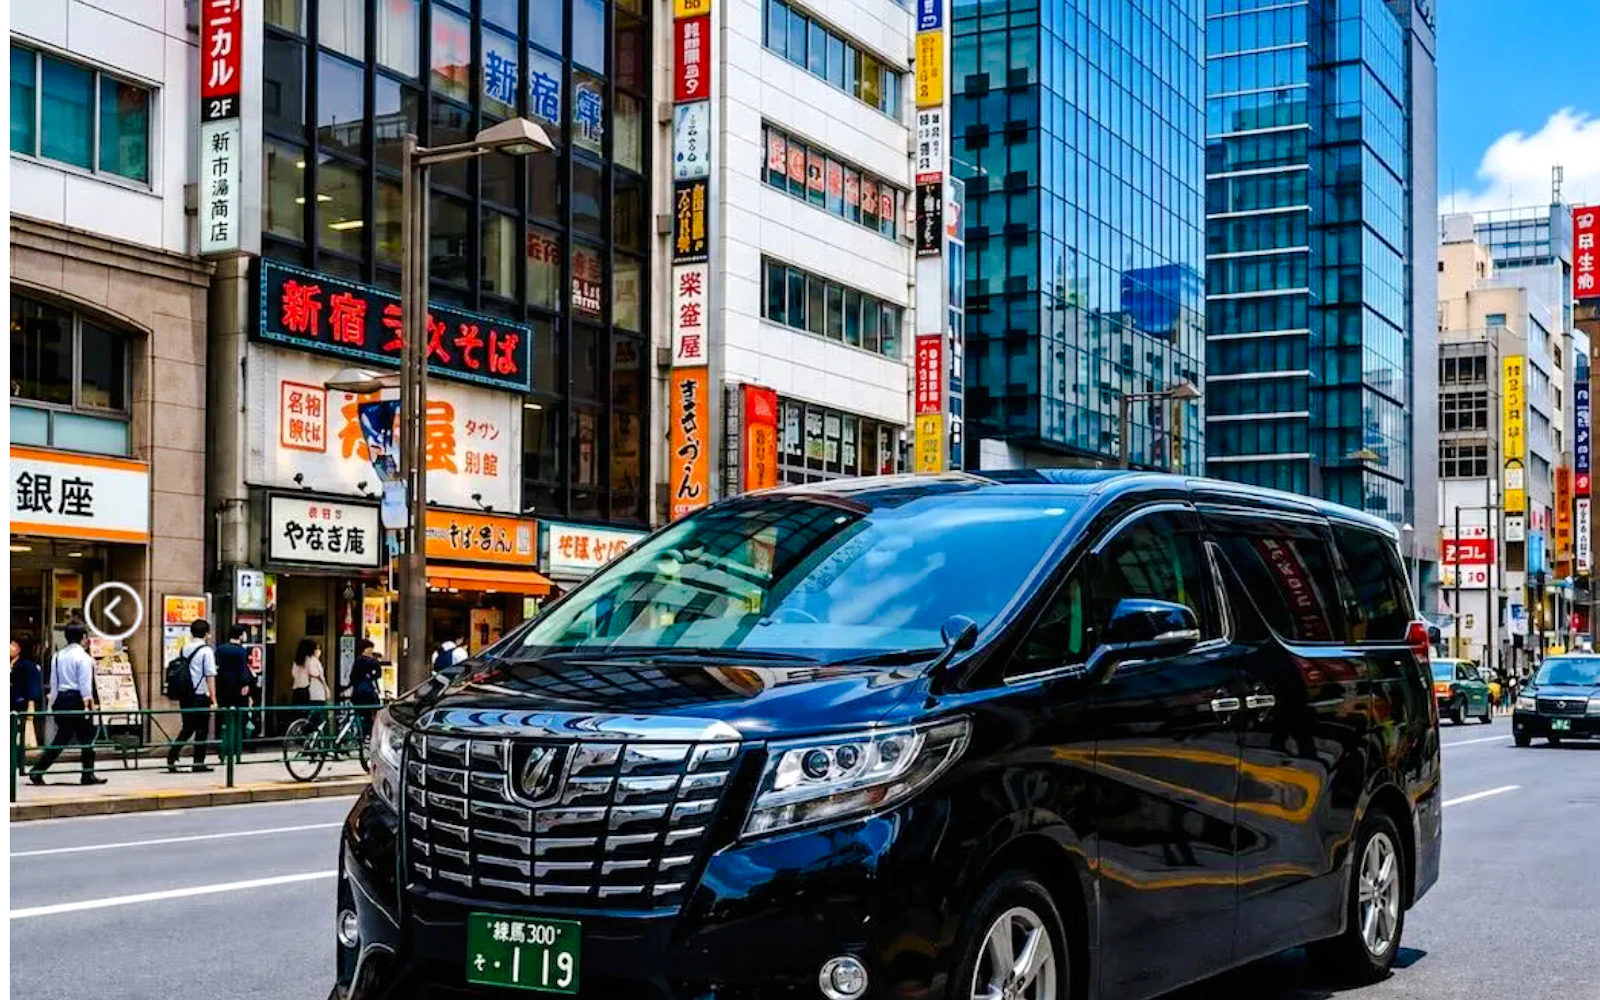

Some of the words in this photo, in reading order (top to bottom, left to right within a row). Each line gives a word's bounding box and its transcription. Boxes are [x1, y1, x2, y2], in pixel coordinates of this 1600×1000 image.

[210, 99, 232, 118] 2F
[338, 390, 458, 475] 屋
[16, 471, 95, 517] 銀座
[283, 520, 364, 554] やなぎ庵
